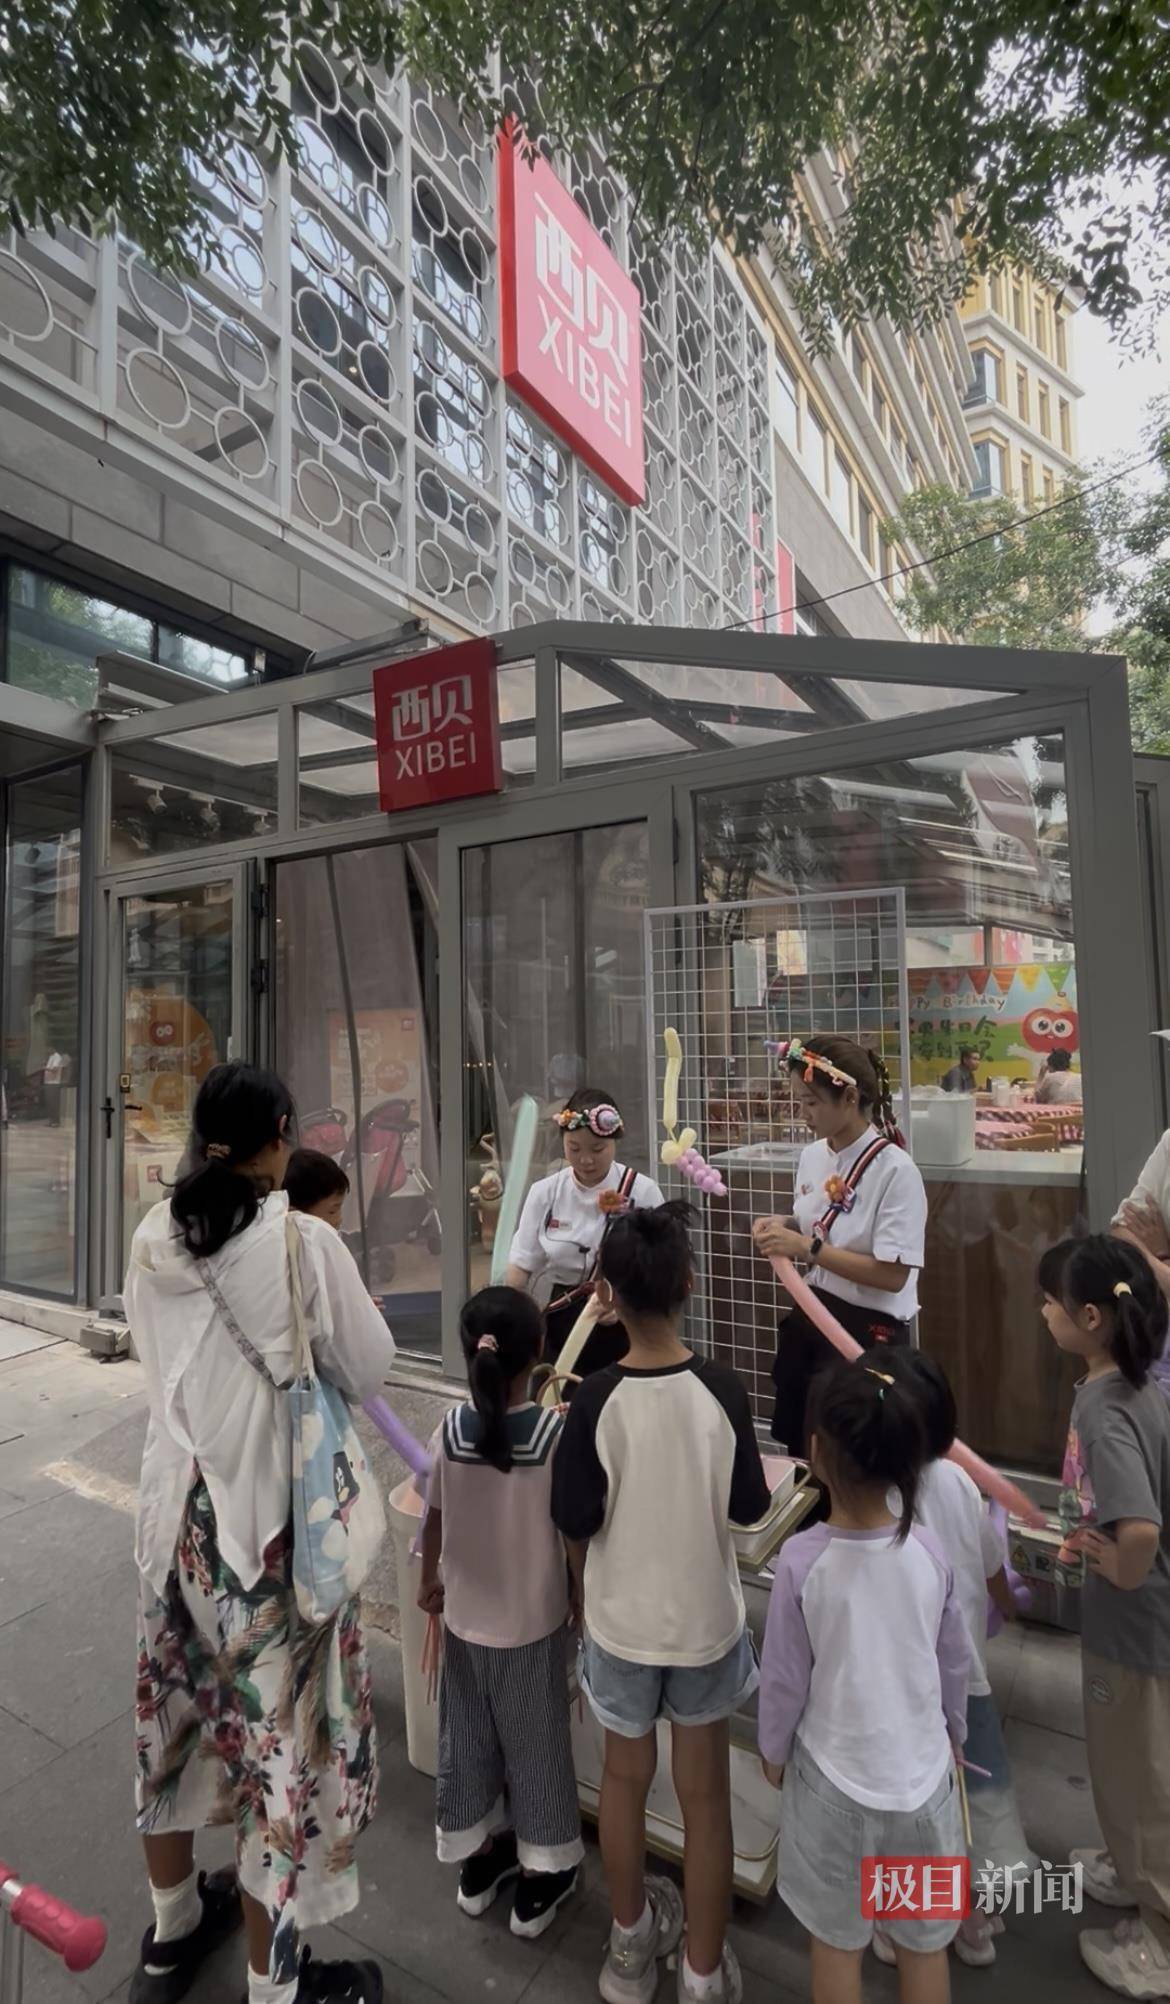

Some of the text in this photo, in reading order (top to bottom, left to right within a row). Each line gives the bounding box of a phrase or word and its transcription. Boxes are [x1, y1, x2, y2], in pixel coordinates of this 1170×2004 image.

[535, 192, 629, 386] 西贝
[538, 297, 632, 447] XIBEI
[391, 674, 473, 742] 西贝
[395, 732, 477, 780] XIBEI
